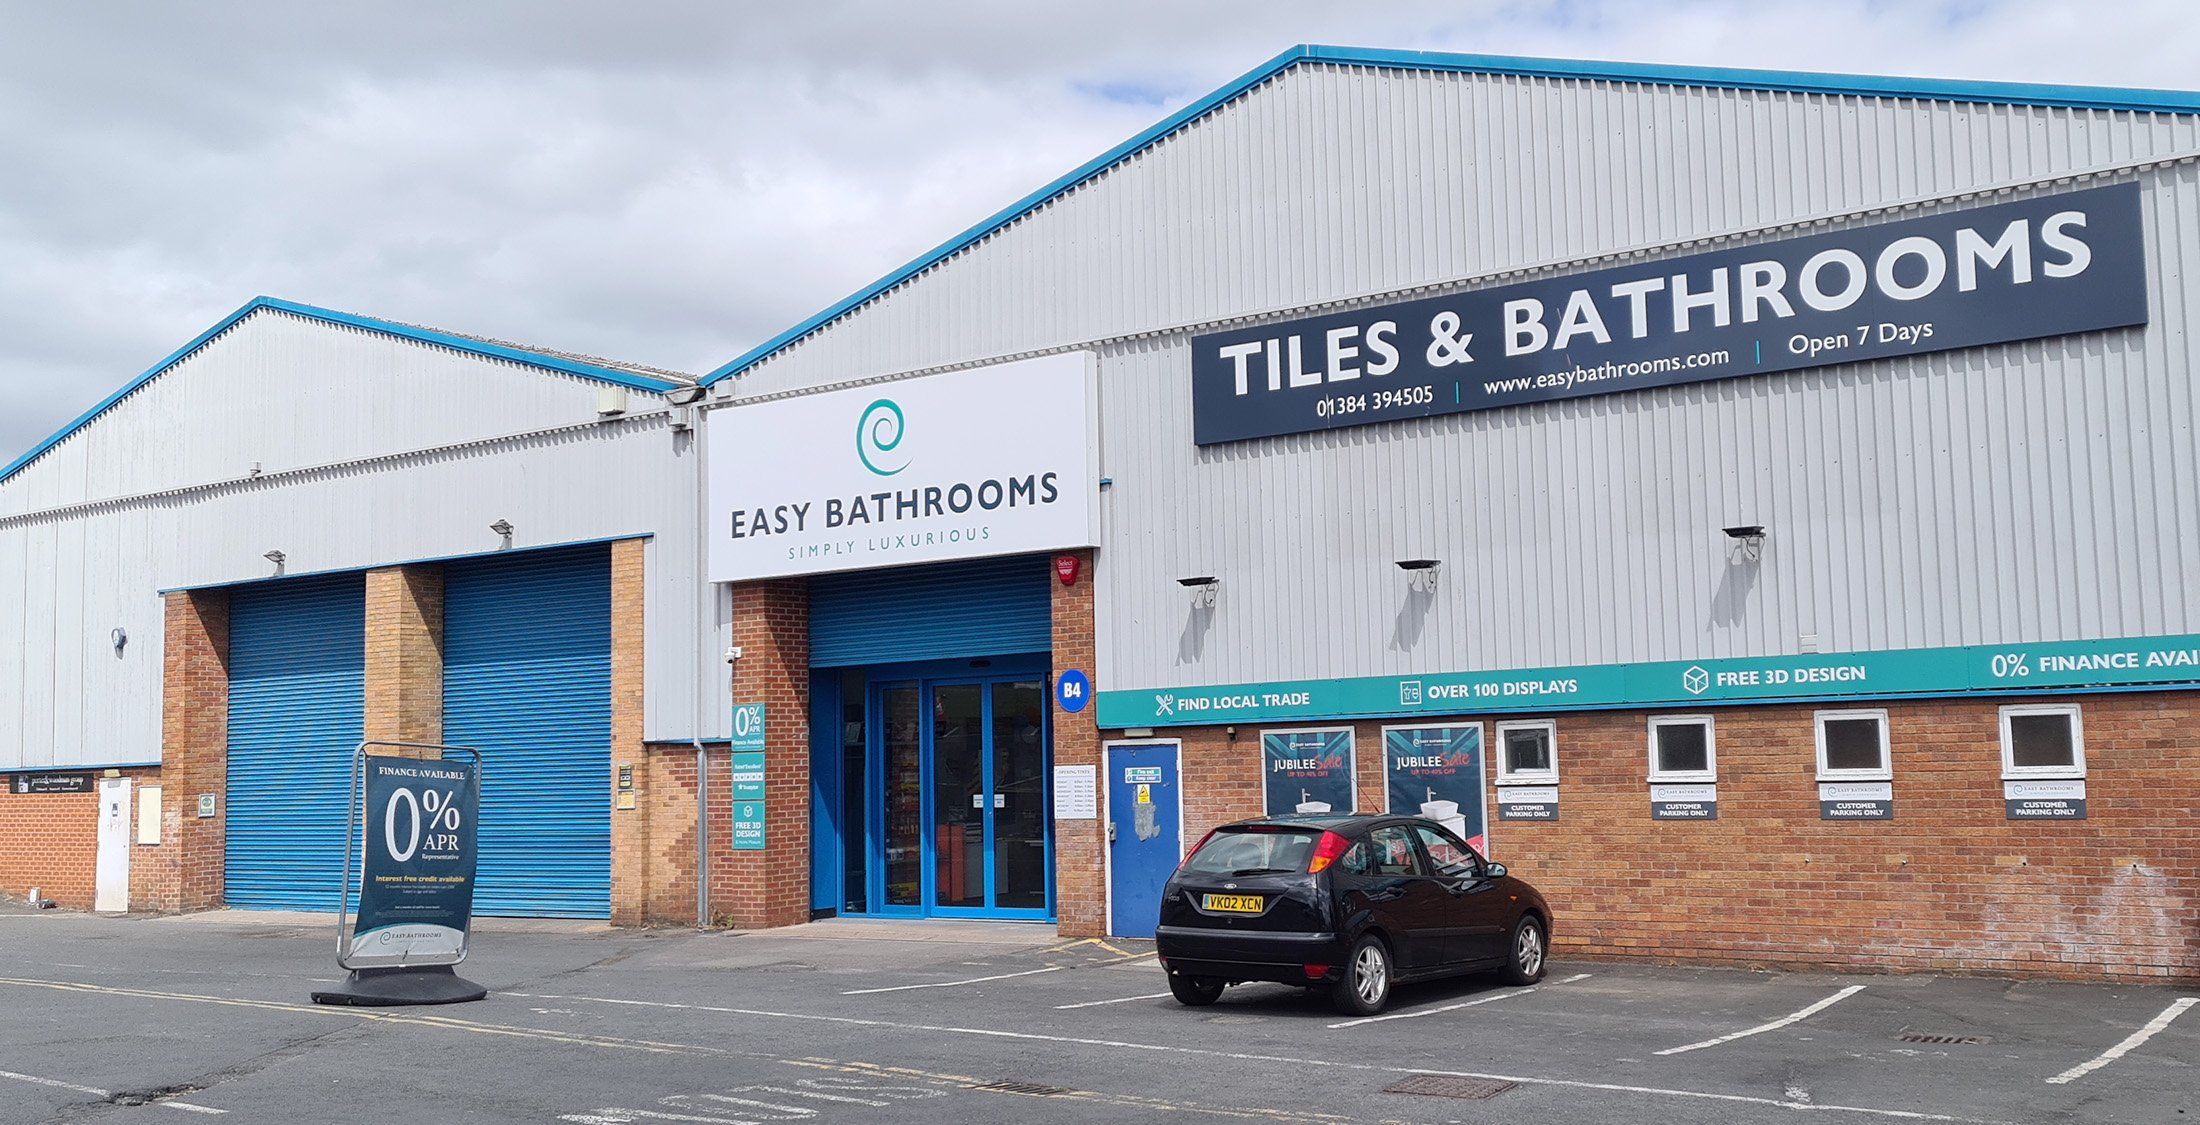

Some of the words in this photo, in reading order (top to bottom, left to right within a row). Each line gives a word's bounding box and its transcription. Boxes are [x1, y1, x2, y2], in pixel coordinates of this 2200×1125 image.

[1219, 320, 1400, 397] TILES
[1425, 312, 1474, 367] &
[1503, 211, 2092, 359] BATHROOMS
[1788, 334, 1849, 358] Open
[1857, 326, 1870, 346] 7
[1879, 321, 1934, 346] Days
[1484, 347, 1729, 395] www.easybathrooms.com
[1316, 394, 1367, 417] 01384
[1372, 385, 1434, 410] 394505
[731, 502, 811, 539] EASY
[826, 472, 1058, 528] BATHROOMS
[788, 541, 855, 560] SIMPLY
[868, 527, 990, 551] LUXURIOUS
[1991, 653, 2030, 677] 0%
[2039, 653, 2139, 672] FINANCE
[2145, 649, 2200, 668] AVAI
[1717, 671, 1760, 686] FREE
[1765, 669, 1789, 684] 3D
[1795, 666, 1866, 683] DESIGN
[1064, 683, 1081, 698] B4
[1428, 685, 1469, 699] OVER
[1474, 683, 1499, 697] 100
[1503, 679, 1577, 696] DISPLAYS
[1178, 699, 1209, 711] FIND
[1214, 695, 1259, 709] LOCAL
[1262, 692, 1310, 707] TRADE
[735, 706, 761, 737] 0%
[1274, 759, 1316, 772] JUBILEE
[1314, 752, 1342, 770] Sale
[1397, 756, 1442, 770] JUBILEE
[1440, 751, 1471, 769] Sale
[379, 767, 417, 777] FINANCE
[419, 770, 465, 780] AVAILABLE
[385, 787, 460, 862] 0%
[736, 830, 760, 838] DESIGN
[752, 821, 761, 829] 3D
[423, 834, 459, 850] APR
[375, 875, 402, 883] Interest
[403, 875, 417, 883] free
[418, 875, 438, 883] credit
[438, 875, 465, 883] available
[1210, 896, 1238, 909] VK02
[1240, 897, 1262, 910] XCN
